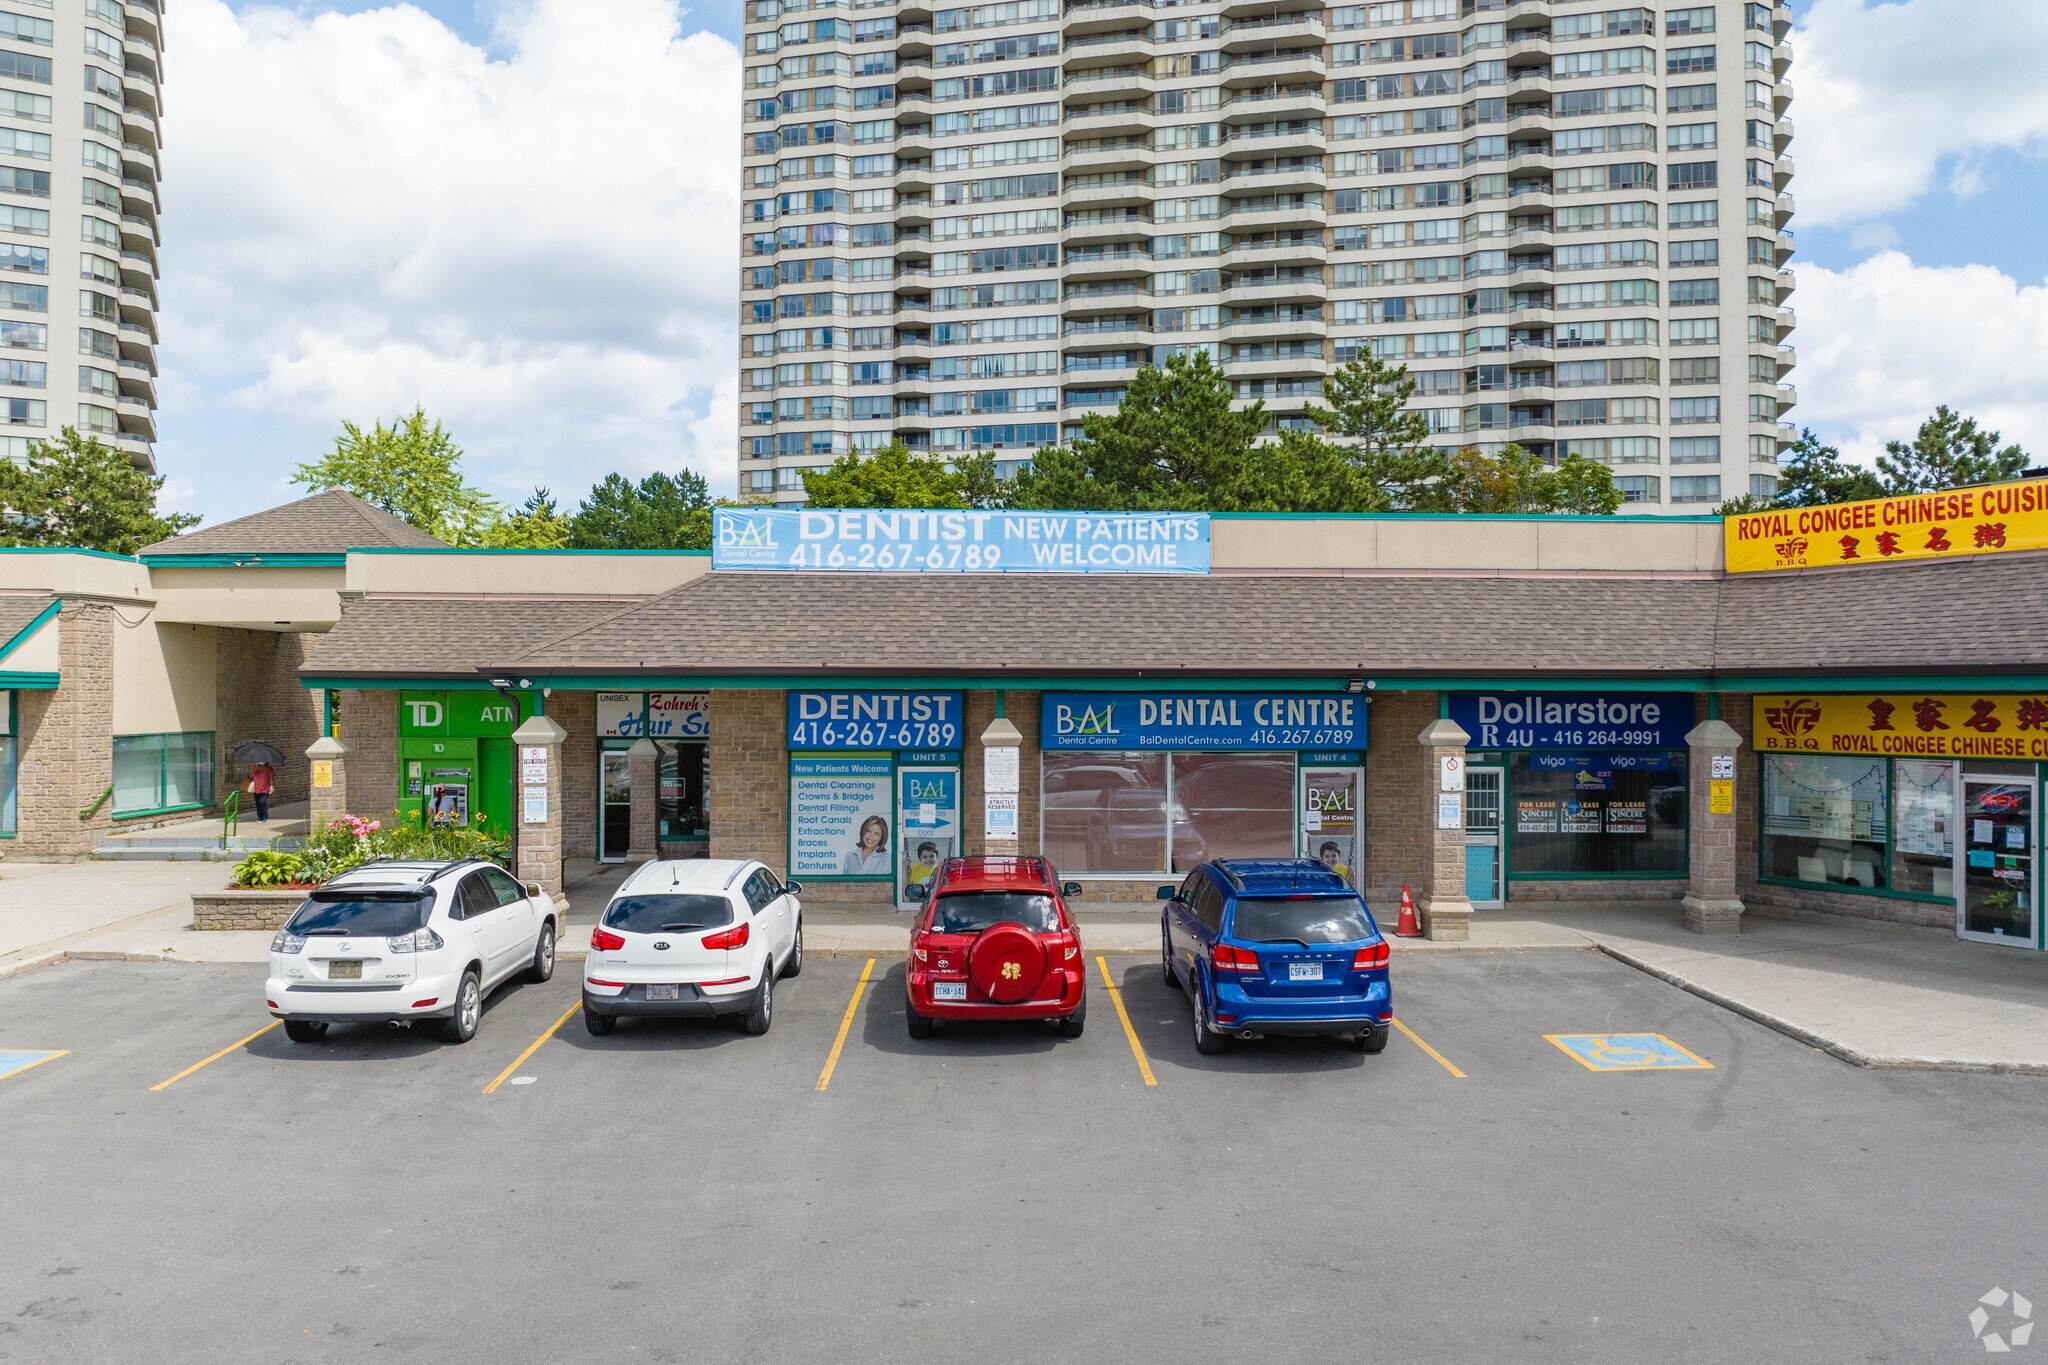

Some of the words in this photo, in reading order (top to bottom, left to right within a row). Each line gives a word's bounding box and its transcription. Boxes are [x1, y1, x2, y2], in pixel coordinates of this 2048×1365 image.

[1738, 514, 1793, 540] ROYAL
[1799, 504, 1876, 535] CONGEE
[1882, 493, 1974, 526] CHINESE
[1981, 484, 2048, 516] CUISI
[719, 516, 778, 546] BAL
[800, 512, 991, 541] DENTIST
[1004, 517, 1069, 540] NEW
[1076, 518, 1199, 541] PATIENTS
[721, 549, 747, 558] Dental
[749, 549, 776, 558] Centre
[789, 543, 1001, 569] 416-267-6789
[1032, 543, 1177, 565] WELCOME
[649, 694, 709, 711] Zohreh's
[800, 695, 952, 721] DENTIST
[1479, 696, 1661, 725] Dollarstore
[405, 701, 443, 727] TD
[1057, 704, 1120, 734] BAL
[1140, 699, 1242, 726] DENTAL
[1254, 699, 1354, 726] CENTRE
[793, 722, 955, 747] 416-267-6789
[1140, 735, 1242, 745] BalDentalCentre.com
[1250, 729, 1354, 744] 416.267.6789
[1480, 725, 1500, 747] R
[1506, 730, 1534, 747] 4U
[1553, 730, 1583, 745] 416
[1587, 730, 1660, 745] 264-9991
[432, 743, 445, 753] TD
[1766, 737, 1820, 750] B.B.Q
[1832, 734, 1878, 752] ROYAL
[1882, 735, 1946, 754] CONGEE
[1951, 736, 2026, 757] CHINESE
[912, 753, 937, 761] UNIT
[940, 753, 946, 761] 5
[1540, 755, 1566, 768] vigo
[1610, 755, 1636, 768] vigo
[795, 764, 814, 773] New
[816, 764, 849, 773] Patients
[851, 764, 889, 773] Welcome
[798, 781, 828, 789] Dental
[830, 781, 875, 790] Cleanings
[910, 779, 947, 798] BAL
[842, 793, 874, 802] Bridges
[1308, 788, 1354, 811] BAL
[1979, 793, 2018, 807] OPEN
[798, 804, 828, 812] Dental
[830, 804, 860, 813] Fillings
[798, 816, 819, 824] Root
[820, 816, 852, 824] Canals
[798, 827, 846, 835] Extractions
[798, 839, 828, 847] Braces
[798, 850, 837, 859] Implants
[798, 861, 837, 870] Dentures
